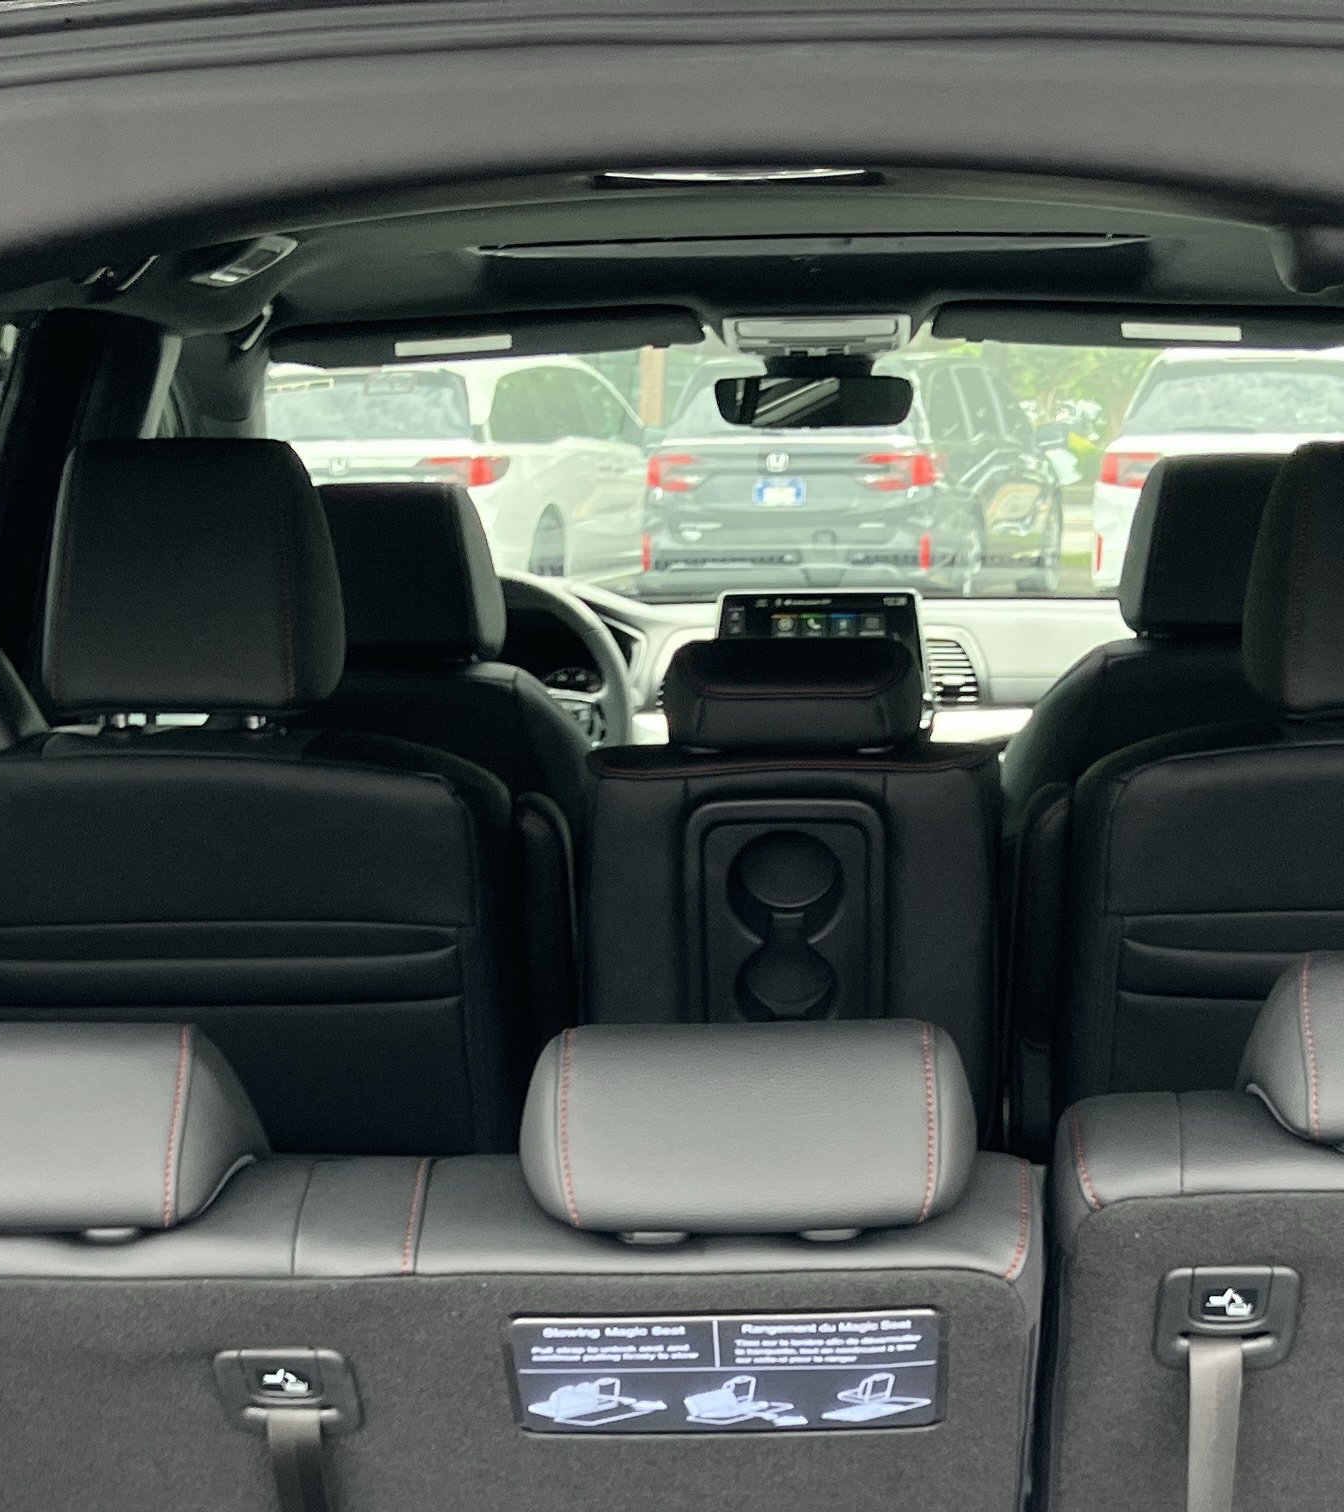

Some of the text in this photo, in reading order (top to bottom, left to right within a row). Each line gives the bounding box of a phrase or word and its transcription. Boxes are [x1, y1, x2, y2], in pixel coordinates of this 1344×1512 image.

[605, 1326, 648, 1338] Magic
[651, 1326, 685, 1336] Seat
[838, 1321, 878, 1333] Magic
[880, 1320, 912, 1330] Seat
